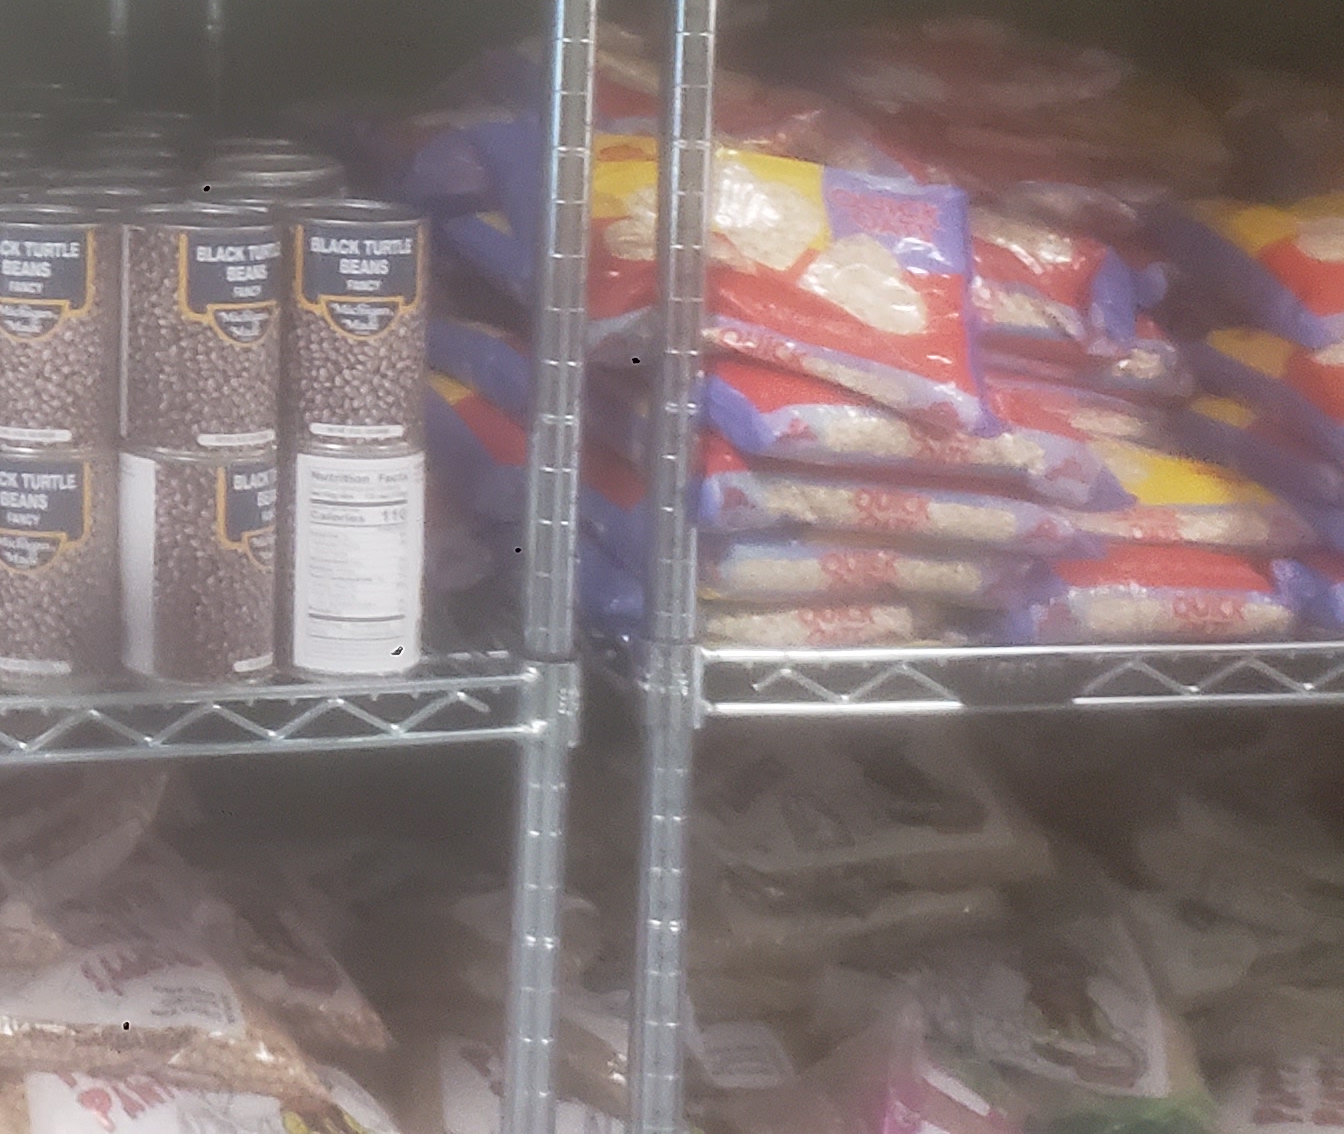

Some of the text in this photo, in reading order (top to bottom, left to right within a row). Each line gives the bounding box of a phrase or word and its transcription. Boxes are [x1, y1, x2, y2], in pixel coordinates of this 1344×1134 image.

[26, 241, 80, 259] TURTLE
[196, 243, 246, 263] BLACK
[310, 236, 412, 255] BLACK TURTLE
[2, 260, 51, 277] BEANS
[339, 258, 389, 275] BEANS
[21, 472, 77, 490] TURTLE
[0, 492, 49, 509] BEANS
